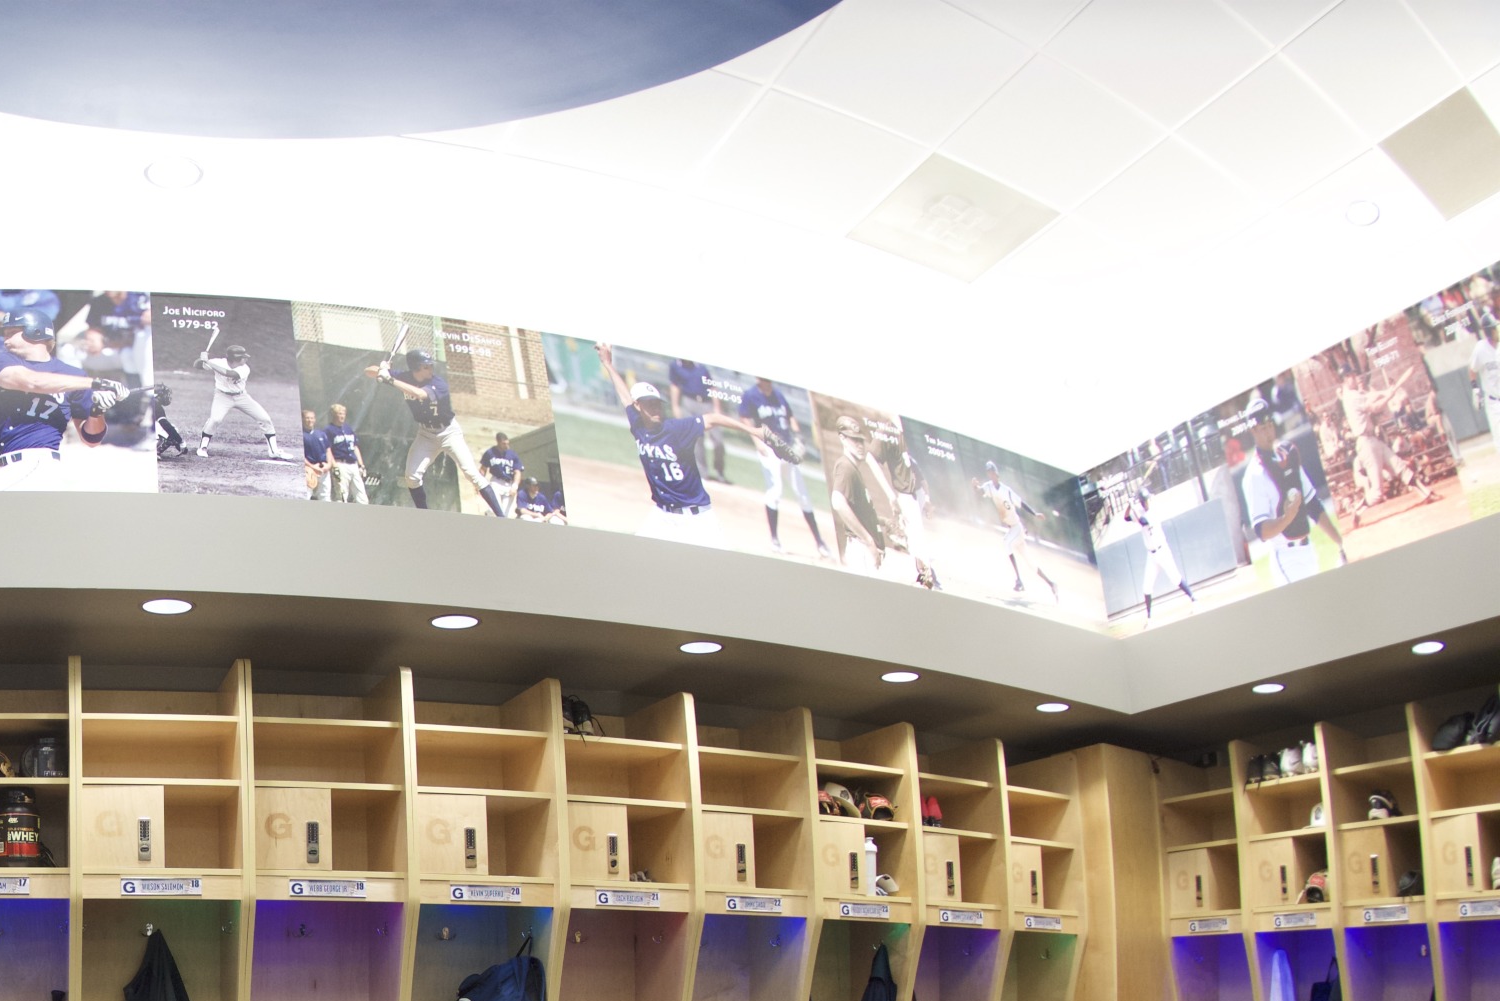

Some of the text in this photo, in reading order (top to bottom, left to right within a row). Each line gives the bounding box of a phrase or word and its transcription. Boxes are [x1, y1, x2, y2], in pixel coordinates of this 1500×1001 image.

[163, 306, 225, 318] JOE NICIFORO
[172, 320, 219, 330] 1979-82
[435, 329, 460, 340] KEVIN
[449, 344, 491, 357] 1995-98
[706, 389, 743, 404] 2002-05
[26, 398, 59, 420] 17
[661, 462, 684, 482] 16
[264, 812, 292, 839] G
[425, 819, 452, 844] G
[12, 831, 39, 842] WHEY
[572, 826, 595, 851] G
[123, 882, 135, 893] G
[191, 880, 199, 888] 18
[291, 883, 303, 894] G
[356, 882, 364, 890] 19
[452, 888, 464, 899] G
[598, 893, 608, 904] G
[727, 899, 736, 909] G
[842, 905, 850, 915] G
[942, 912, 949, 921] G
